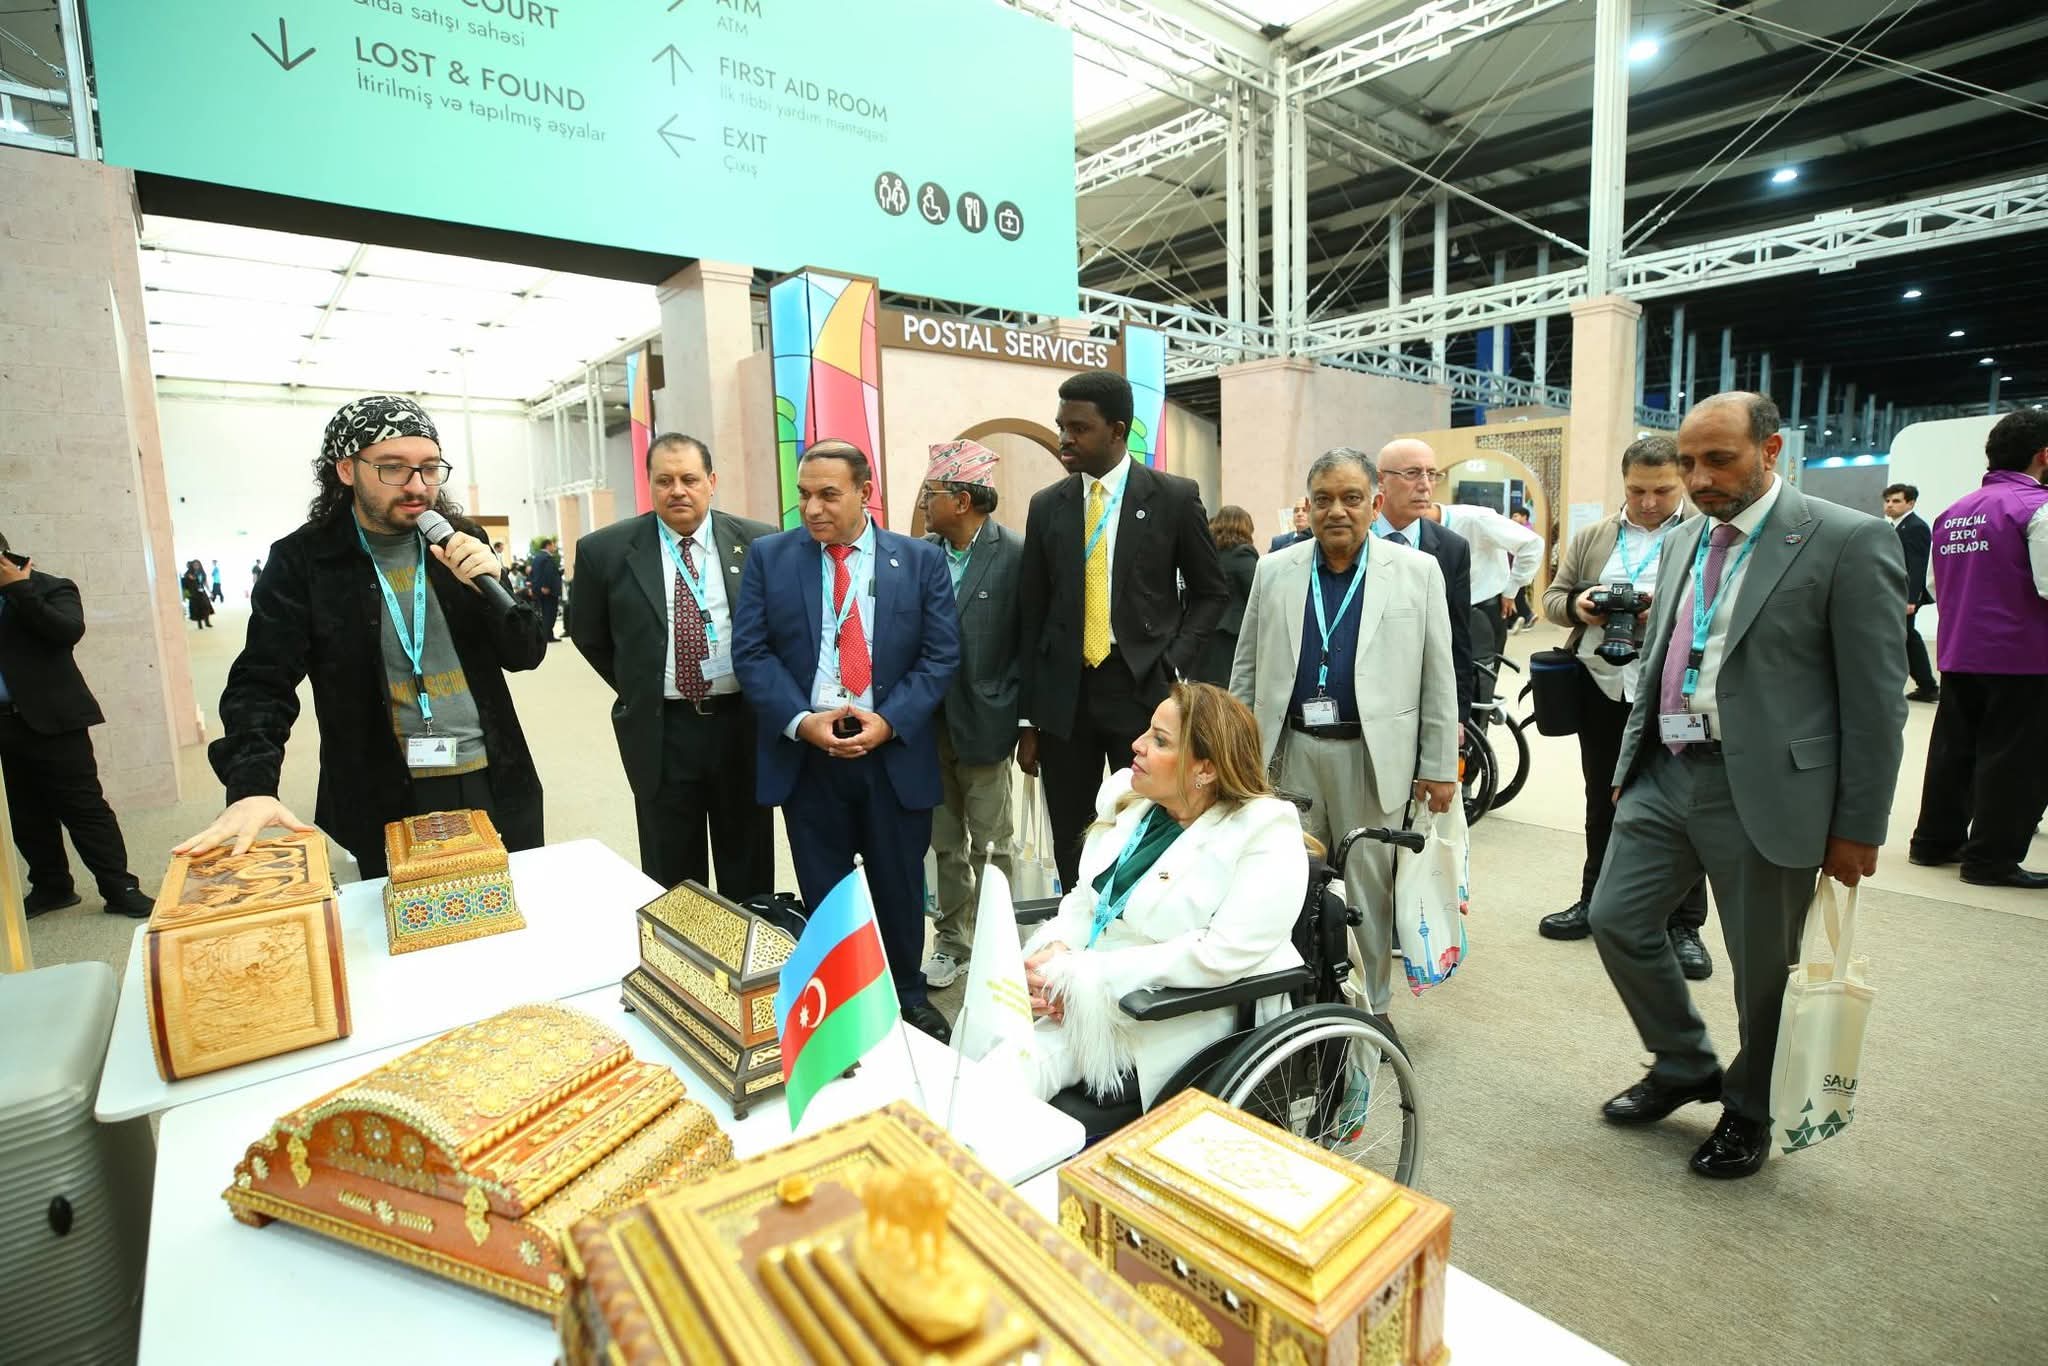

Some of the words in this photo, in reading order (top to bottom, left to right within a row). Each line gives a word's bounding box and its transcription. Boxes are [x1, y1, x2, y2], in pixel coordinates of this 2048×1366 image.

[411, 7, 459, 33] satışı
[468, 20, 525, 48] sahəsi
[463, 0, 559, 29] OURT
[717, 16, 748, 38] ATM
[355, 37, 436, 77] LOST
[448, 60, 470, 86] &
[481, 68, 585, 111] FOUND
[719, 57, 776, 89] FIRST
[784, 78, 819, 101] AID
[827, 88, 888, 122] ROOM
[356, 68, 433, 109] İtirilmiş
[440, 97, 462, 111] və
[469, 100, 541, 132] tapılmış
[547, 118, 606, 142] əşyalar
[723, 127, 768, 154] EXIT
[903, 314, 999, 353] POSTAL
[1005, 330, 1108, 368] SERVICES
[1950, 528, 1977, 541] EXPO
[1823, 1074, 1857, 1090] SAU
